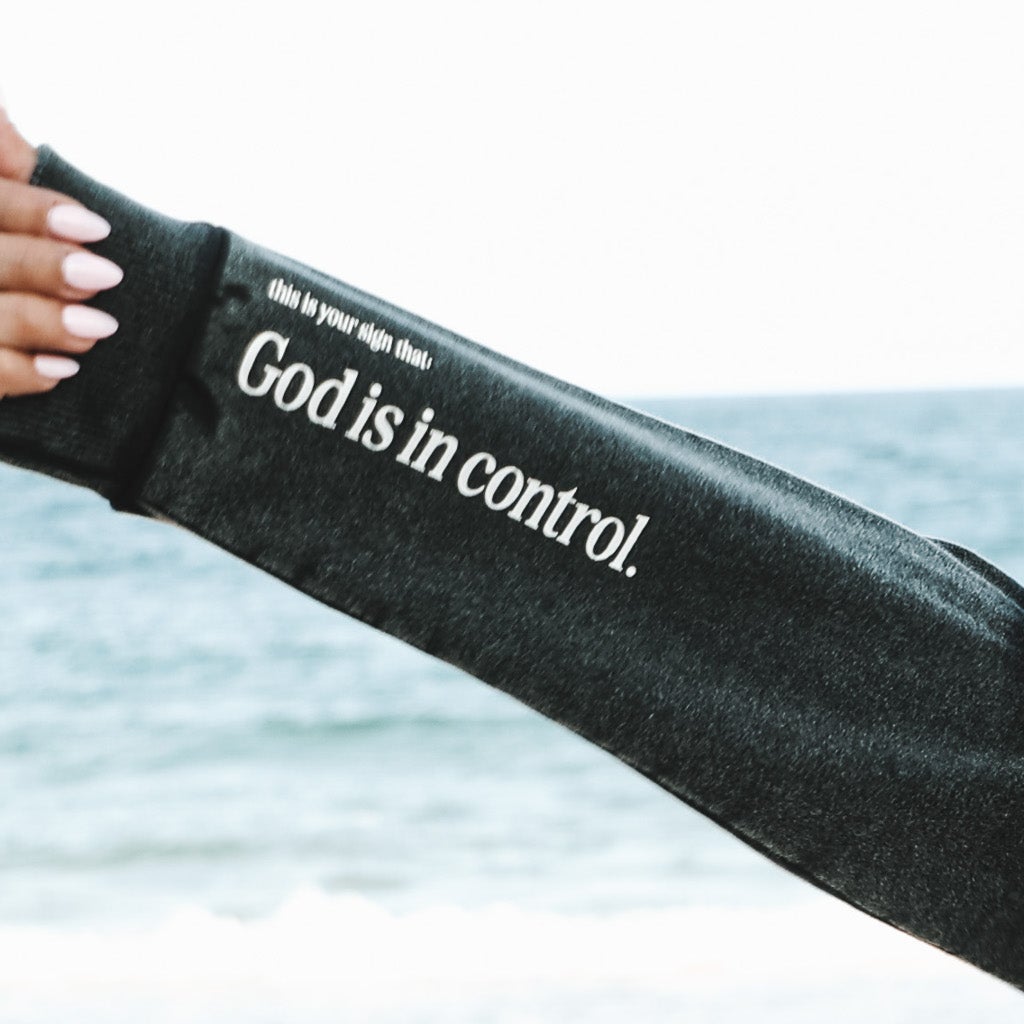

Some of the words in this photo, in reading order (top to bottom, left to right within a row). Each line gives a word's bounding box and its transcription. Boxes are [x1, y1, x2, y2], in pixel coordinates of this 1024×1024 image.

[267, 278, 302, 310] this
[300, 291, 319, 318] is
[316, 302, 360, 335] your
[357, 322, 394, 354] sign
[237, 330, 359, 430] God
[344, 382, 405, 452] is
[395, 407, 459, 482] in
[456, 452, 650, 578] control.
